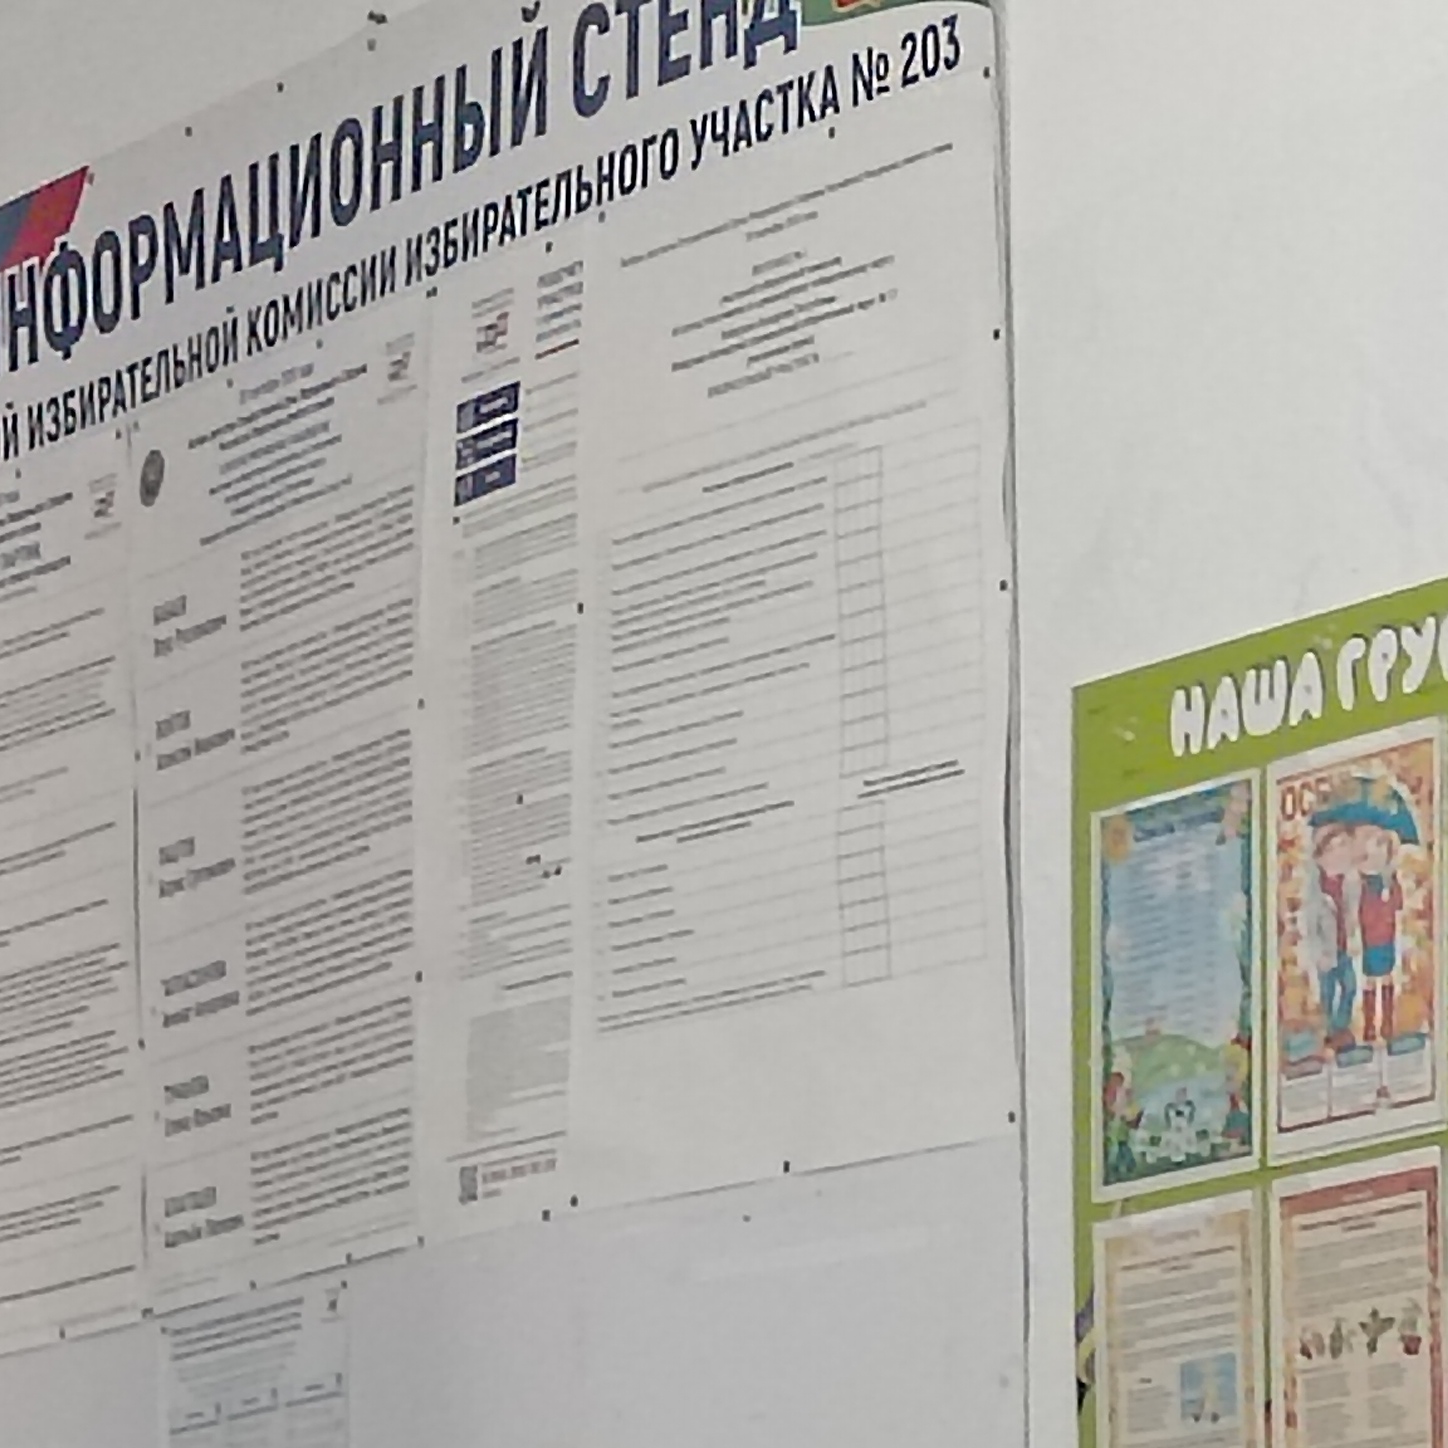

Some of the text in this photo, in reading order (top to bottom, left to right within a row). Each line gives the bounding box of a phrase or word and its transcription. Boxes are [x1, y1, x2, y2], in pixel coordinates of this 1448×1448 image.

[572, 0, 798, 118] СТЕНД
[27, 306, 239, 451] ИЗБИРАТЕЛЬНОЙ
[246, 244, 396, 357] КОМИССИИ
[404, 128, 679, 287] ИЗБИРАТЕЛЬНОГО
[689, 64, 841, 171] УЧАСТКА
[851, 46, 891, 108] №
[900, 13, 961, 88] 203
[1169, 650, 1323, 757] НАША
